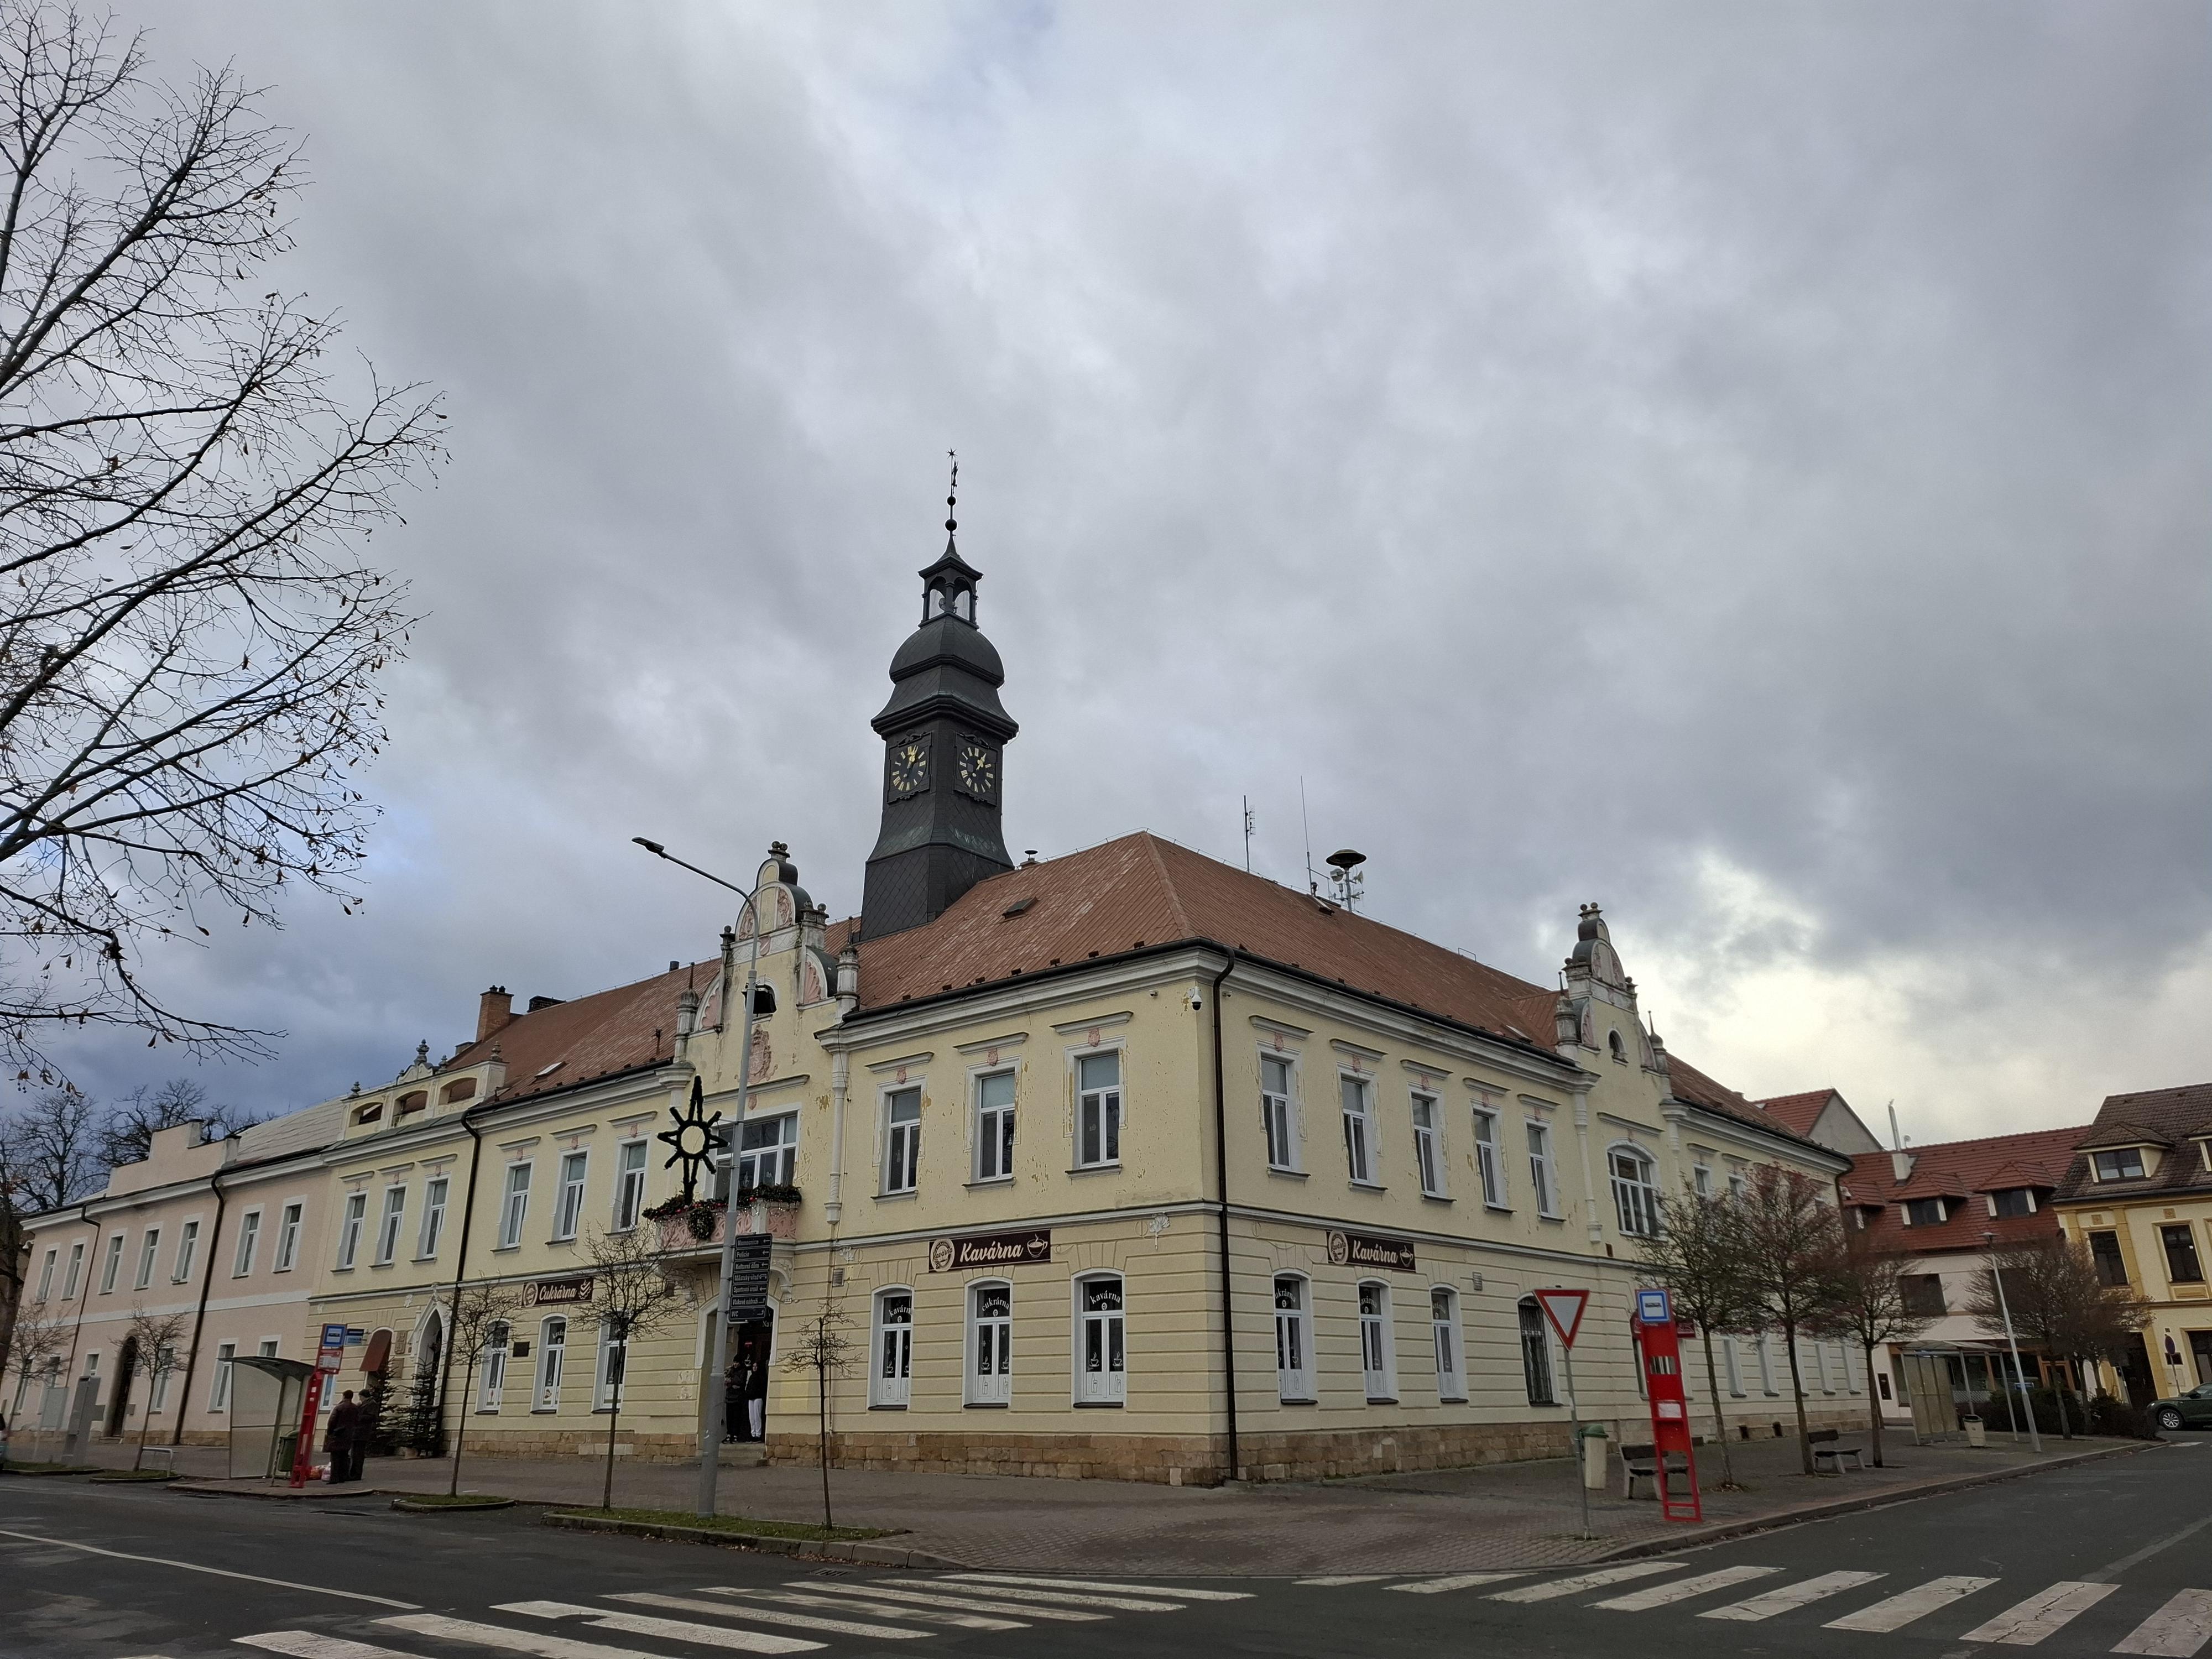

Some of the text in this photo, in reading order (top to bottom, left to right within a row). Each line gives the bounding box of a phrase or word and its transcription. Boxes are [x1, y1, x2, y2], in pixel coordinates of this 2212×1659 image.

[960, 1241, 1024, 1262] Kavárna
[1353, 1240, 1398, 1264] Kavárna
[539, 1285, 577, 1301] Cukrárna
[1090, 1290, 1120, 1305] kavárna
[982, 1297, 1009, 1311] cukrárna
